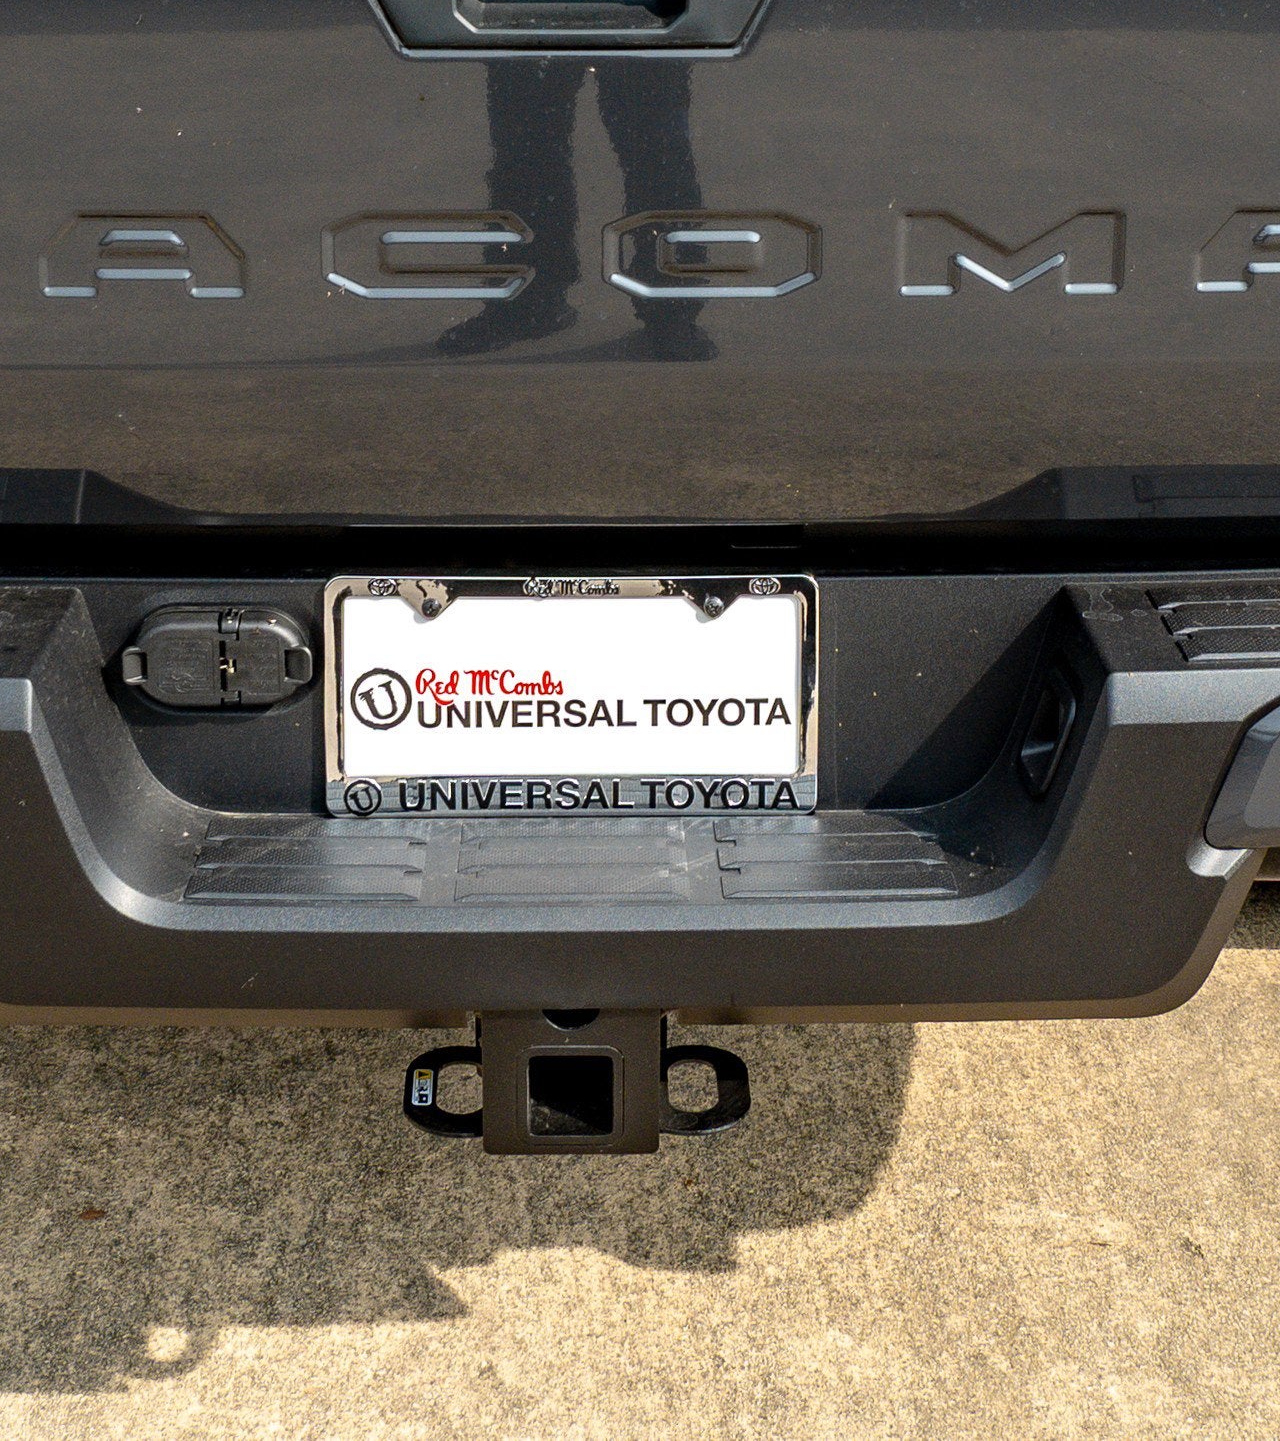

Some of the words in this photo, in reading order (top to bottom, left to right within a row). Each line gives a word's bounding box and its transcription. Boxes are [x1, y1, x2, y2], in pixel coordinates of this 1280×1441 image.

[523, 578, 554, 599] Red
[557, 578, 620, 595] McCombs
[415, 668, 460, 705] Red
[463, 668, 564, 696] McCombs
[417, 698, 637, 729] UNIVERSAL
[644, 697, 791, 726] TOYOTA
[398, 778, 635, 811] UNIVERSAL
[641, 778, 800, 810] TOYOTA
